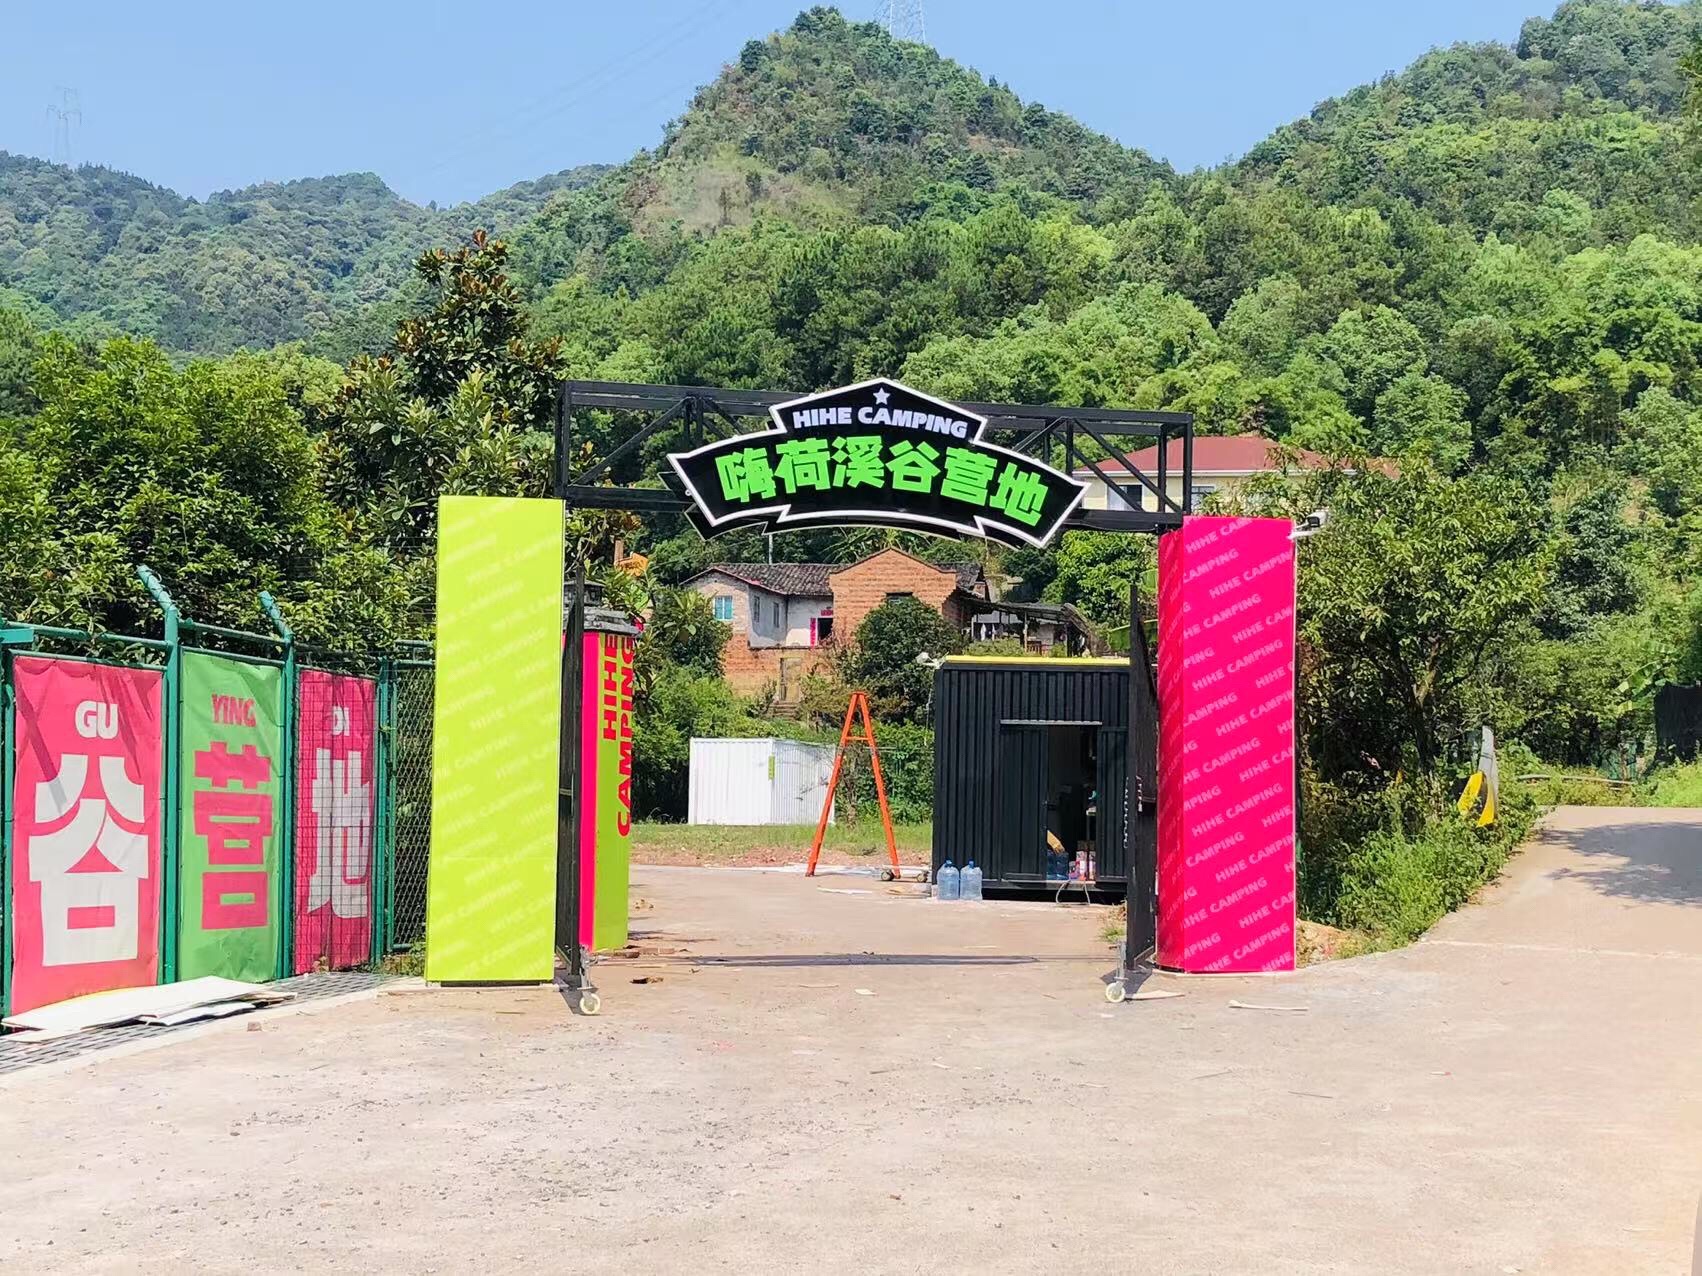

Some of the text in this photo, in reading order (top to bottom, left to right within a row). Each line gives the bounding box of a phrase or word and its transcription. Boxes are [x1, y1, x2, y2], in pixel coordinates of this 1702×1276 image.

[792, 406, 968, 439] HIHE CAMPING
[714, 435, 1050, 526] 嗨荷溪谷营地
[1186, 531, 1218, 554] HIHE
[1209, 576, 1241, 599] HIHE
[1203, 593, 1261, 628] CAMPING
[1232, 621, 1264, 644] HIHE
[1192, 668, 1224, 692] HIHE
[1227, 639, 1283, 673] CAMPING
[1256, 666, 1286, 688] HIHE
[603, 634, 618, 741] HIHE
[75, 700, 119, 738] GU
[211, 692, 256, 727] YING
[332, 706, 350, 736] DI
[1216, 714, 1248, 736] HIHE
[617, 635, 636, 838] CAMPING
[1203, 737, 1260, 772] CAMPING
[1240, 760, 1271, 782] HIHE
[1192, 783, 1283, 837] HIHE CAMPING
[1261, 805, 1292, 828] HIHE
[192, 741, 272, 930] 营
[308, 748, 370, 919] 地
[1186, 832, 1245, 867] CAMPING
[28, 754, 149, 966] 谷
[1216, 859, 1248, 882] HIHE
[1210, 877, 1267, 912] CAMPING
[1239, 906, 1271, 928] HIHE
[1233, 922, 1290, 959] CAMPING
